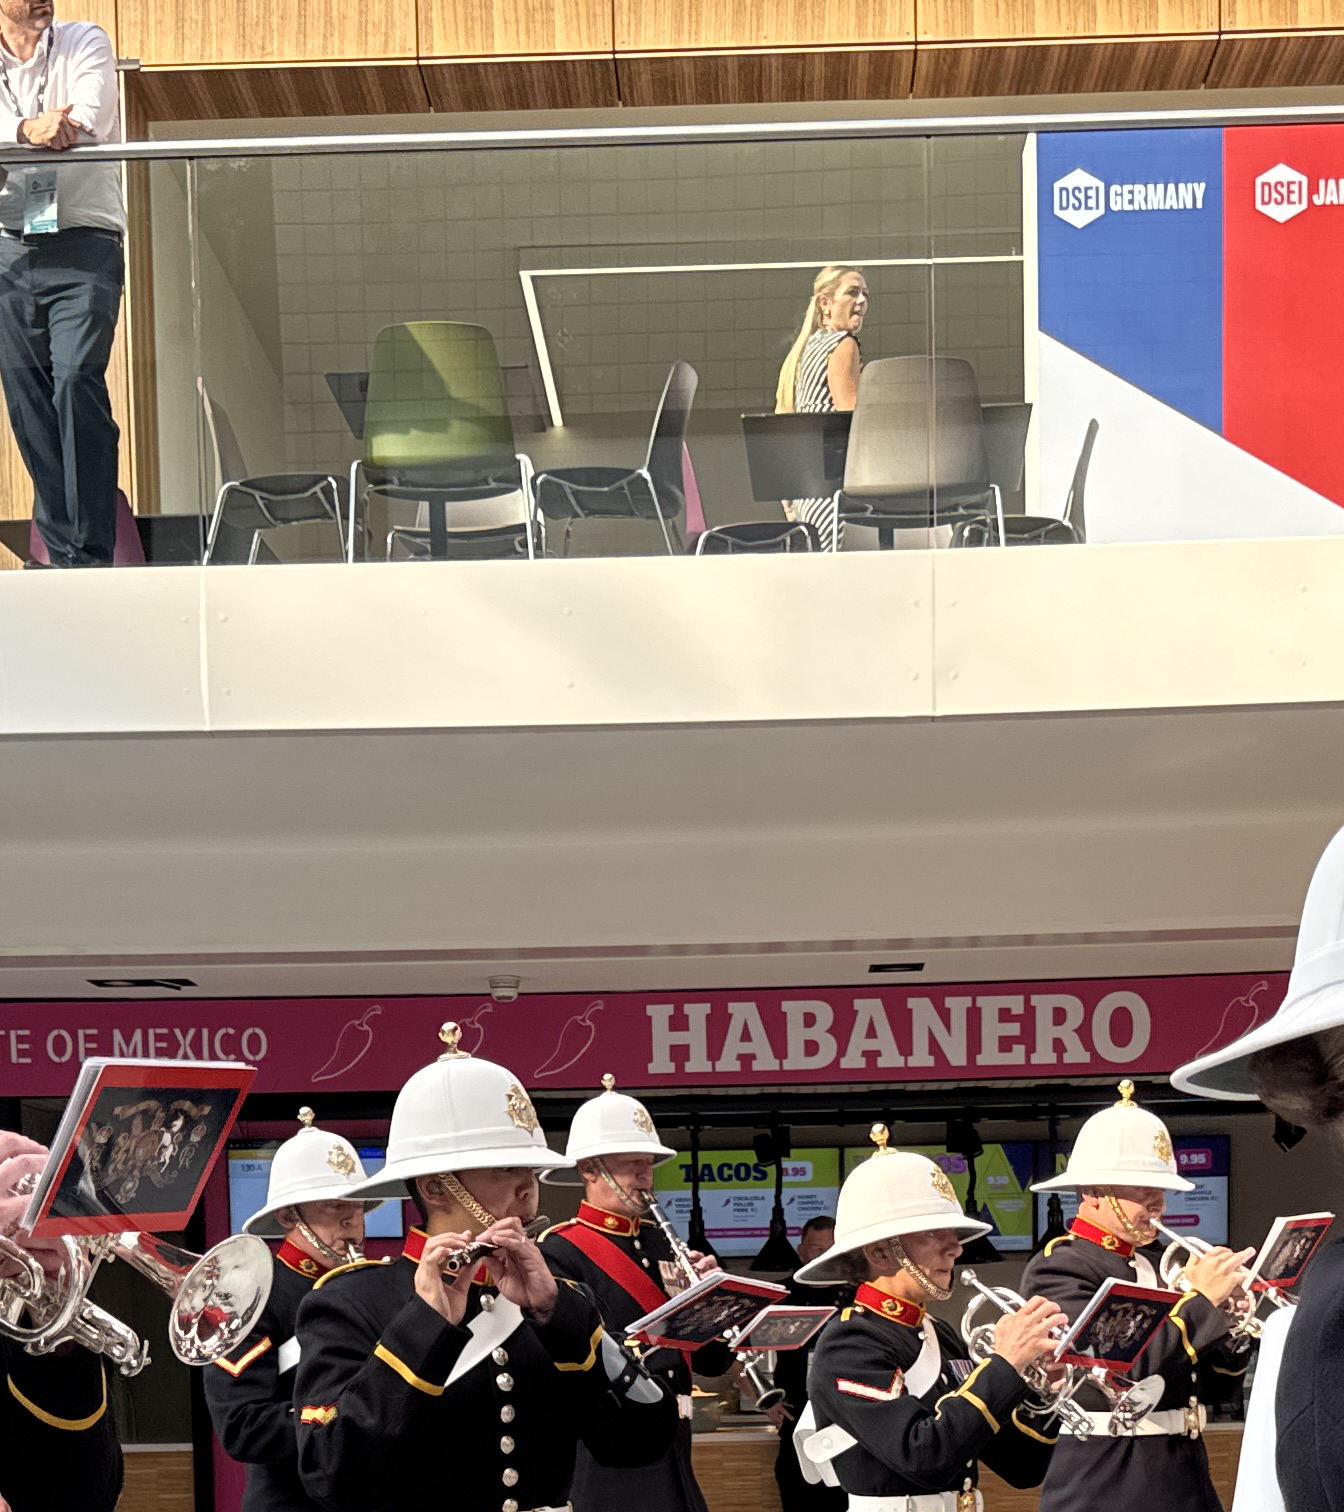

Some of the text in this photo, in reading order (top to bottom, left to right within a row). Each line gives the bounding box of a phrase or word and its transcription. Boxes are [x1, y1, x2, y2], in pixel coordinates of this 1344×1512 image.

[1058, 181, 1206, 212] DSEI GERMANY
[1259, 181, 1303, 207] DSEI
[46, 1028, 99, 1064] OF
[112, 1026, 268, 1062] MEXICO
[645, 991, 1152, 1075] HABANERO
[679, 1161, 769, 1184] TACOS
[1179, 1153, 1207, 1165] 9.95
